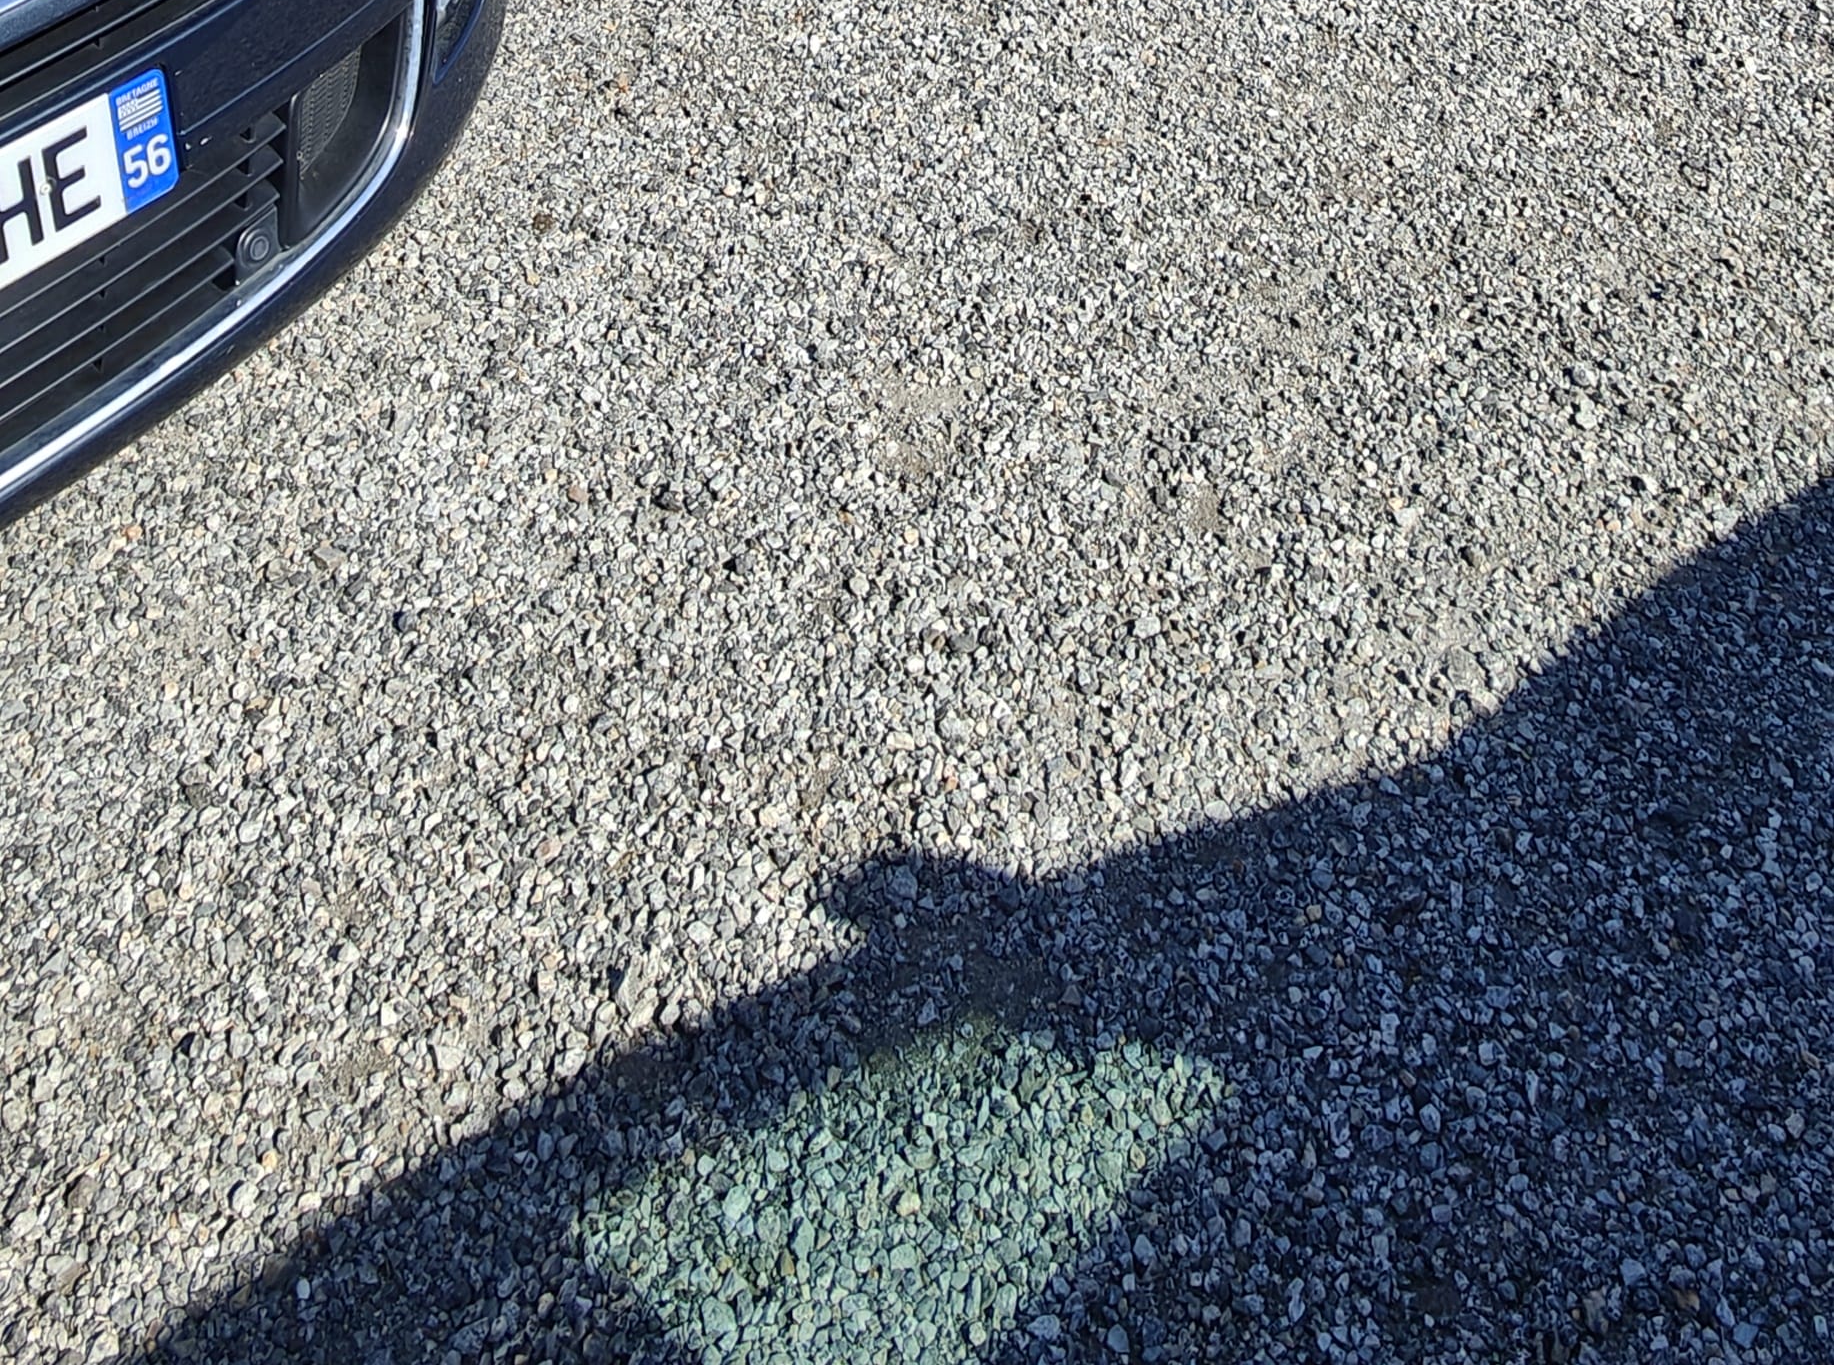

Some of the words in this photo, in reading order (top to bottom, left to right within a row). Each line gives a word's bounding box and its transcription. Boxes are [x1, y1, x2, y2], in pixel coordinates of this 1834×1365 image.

[115, 77, 159, 107] BRETAGNE
[126, 116, 158, 141] BREIZH
[122, 133, 172, 189] 56
[0, 125, 102, 267] HE
